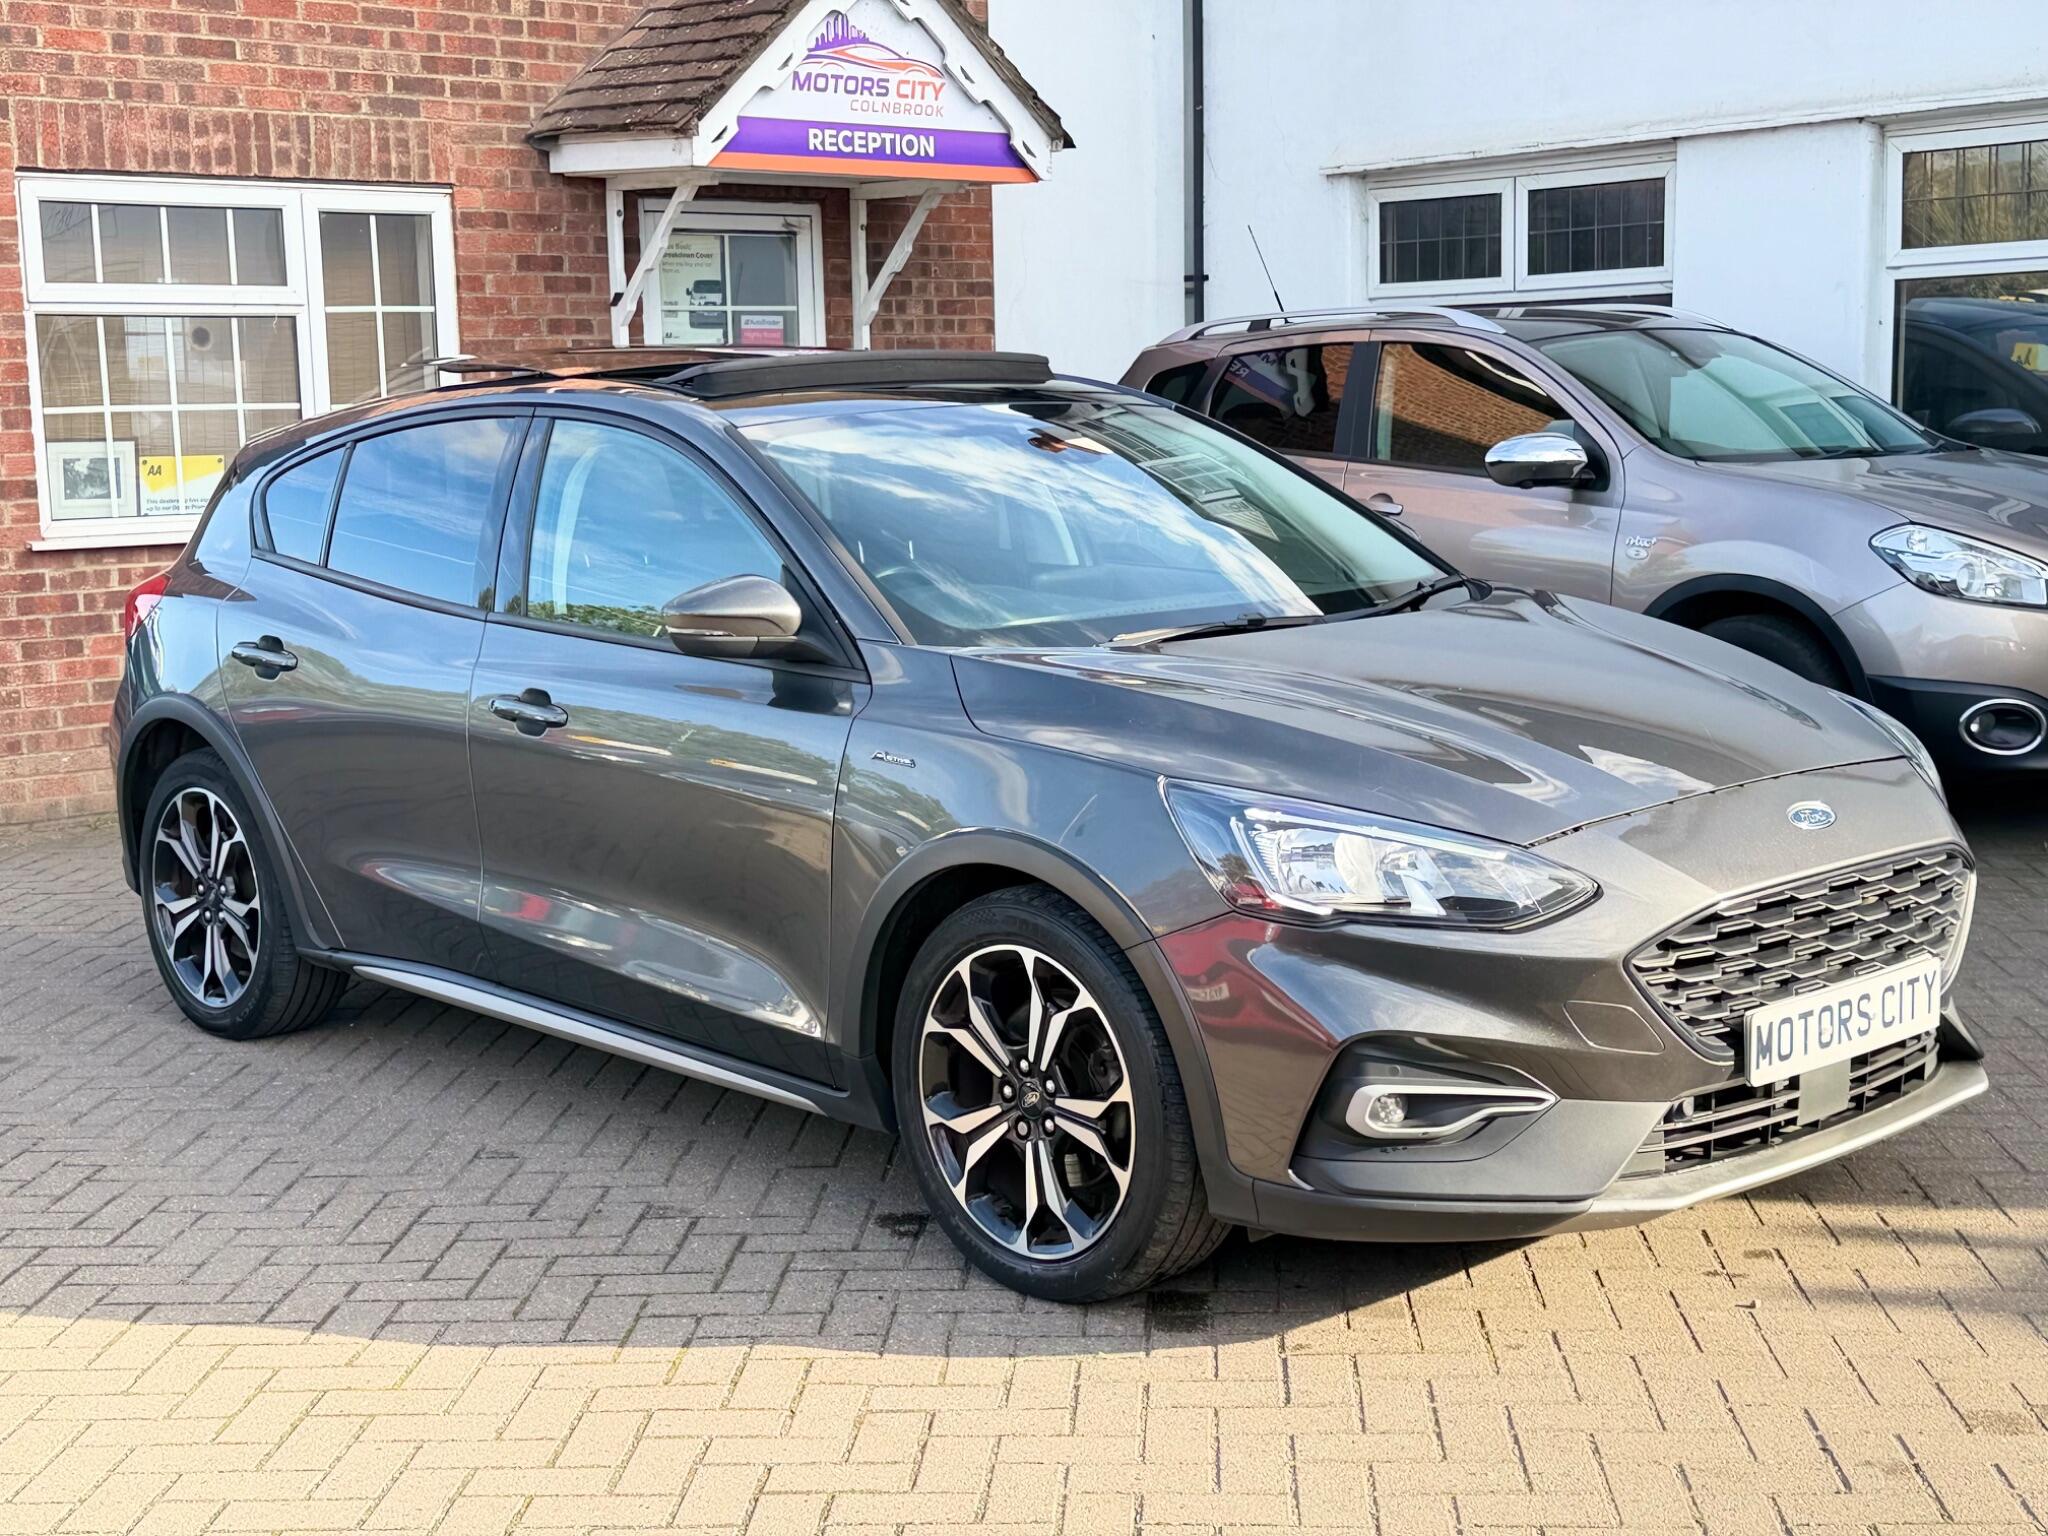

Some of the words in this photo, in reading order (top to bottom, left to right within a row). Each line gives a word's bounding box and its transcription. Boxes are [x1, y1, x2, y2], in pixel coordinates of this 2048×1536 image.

[792, 71, 890, 97] MOTORS
[897, 80, 945, 101] CITY
[850, 99, 945, 118] COLNBROOK
[808, 128, 936, 157] RECEPTION
[147, 464, 162, 477] AA
[1755, 992, 1872, 1070] MOTORS
[1880, 969, 1937, 1029] CITY
